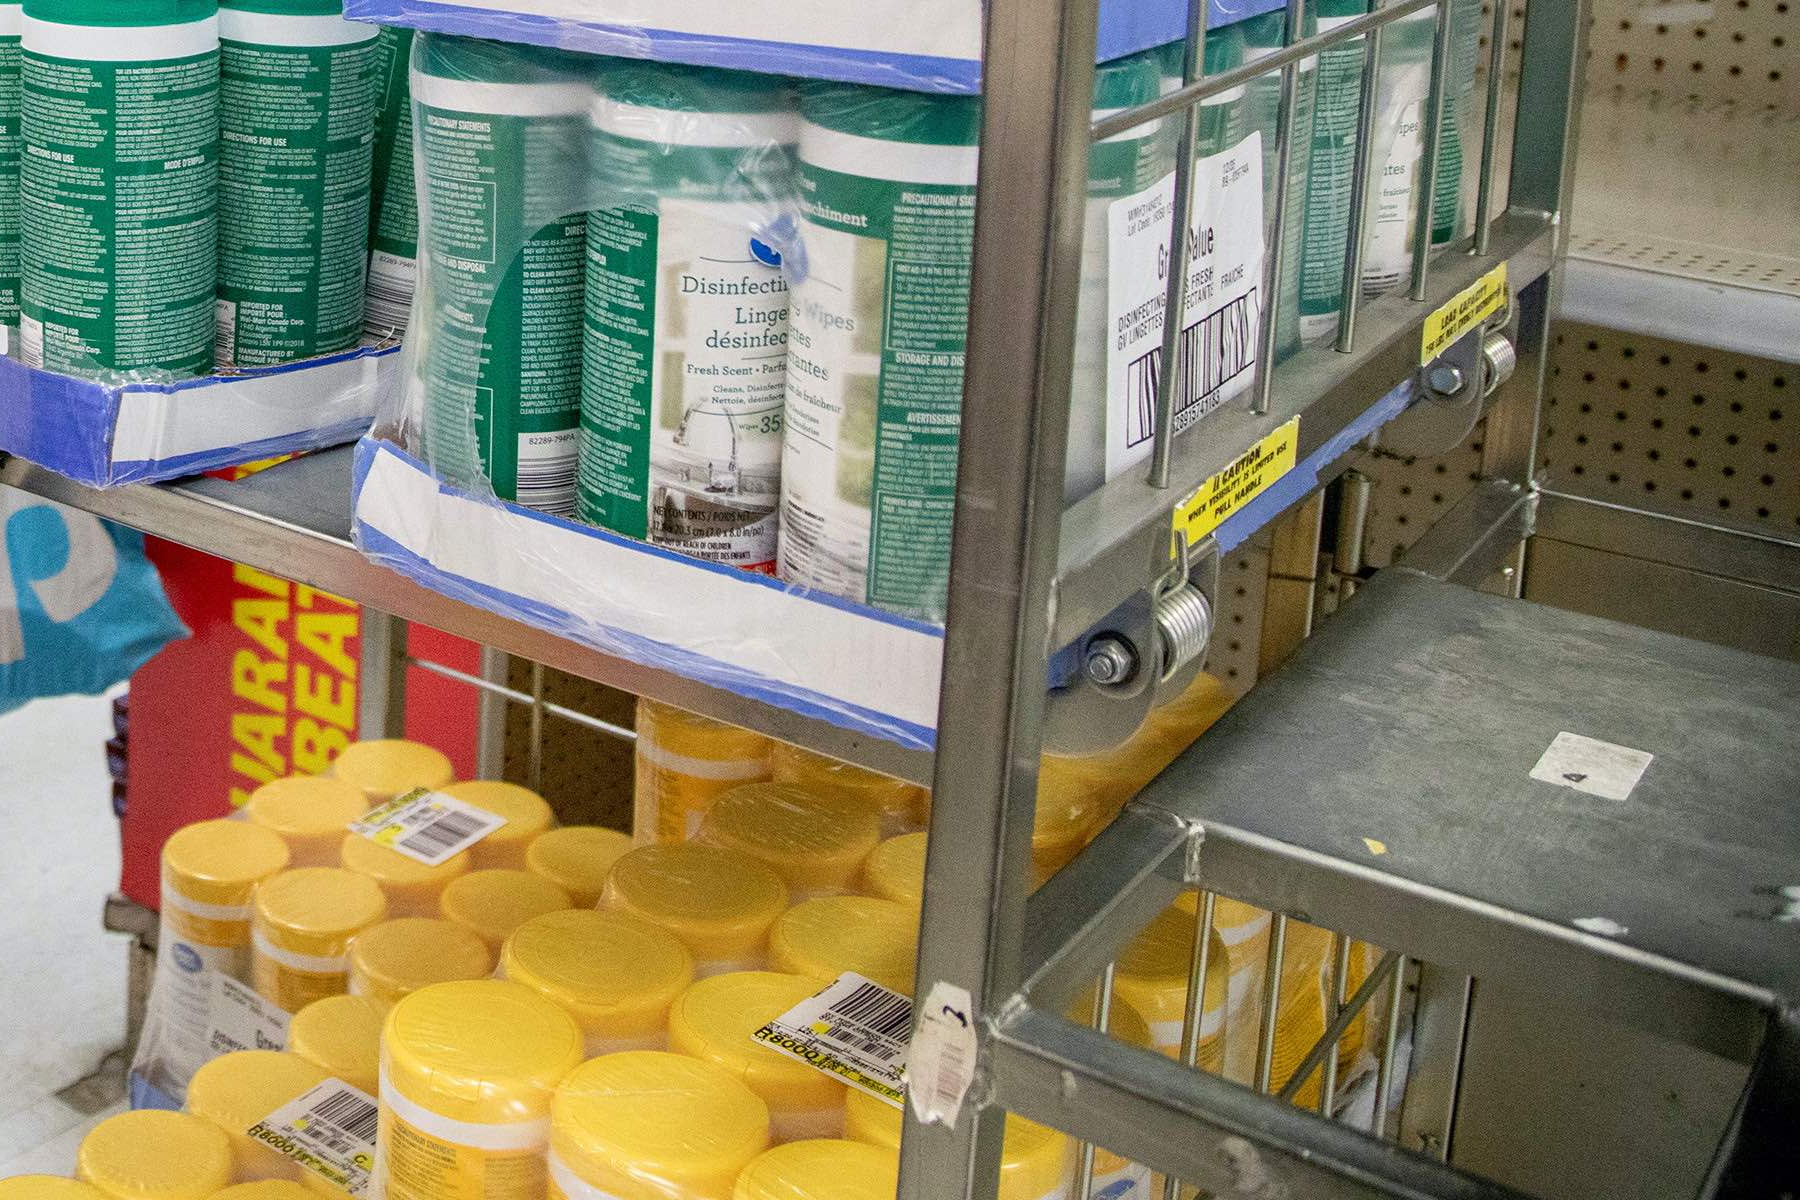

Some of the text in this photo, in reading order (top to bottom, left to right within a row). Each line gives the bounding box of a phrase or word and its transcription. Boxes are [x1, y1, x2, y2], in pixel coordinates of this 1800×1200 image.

[259, 136, 272, 145] FOR
[273, 137, 287, 147] USE
[51, 151, 62, 162] FOR
[62, 153, 75, 164] USE
[271, 303, 284, 311] FOR
[267, 318, 289, 326] Canada
[290, 318, 306, 327] Corp.
[705, 329, 788, 350] désinfec
[895, 353, 950, 367] STORAGE AND
[687, 364, 719, 376] Fresh
[722, 363, 753, 376] Scent
[760, 414, 782, 434] 35
[1222, 446, 1262, 485] CAUTION
[1214, 475, 1262, 519] PULL HANDLE
